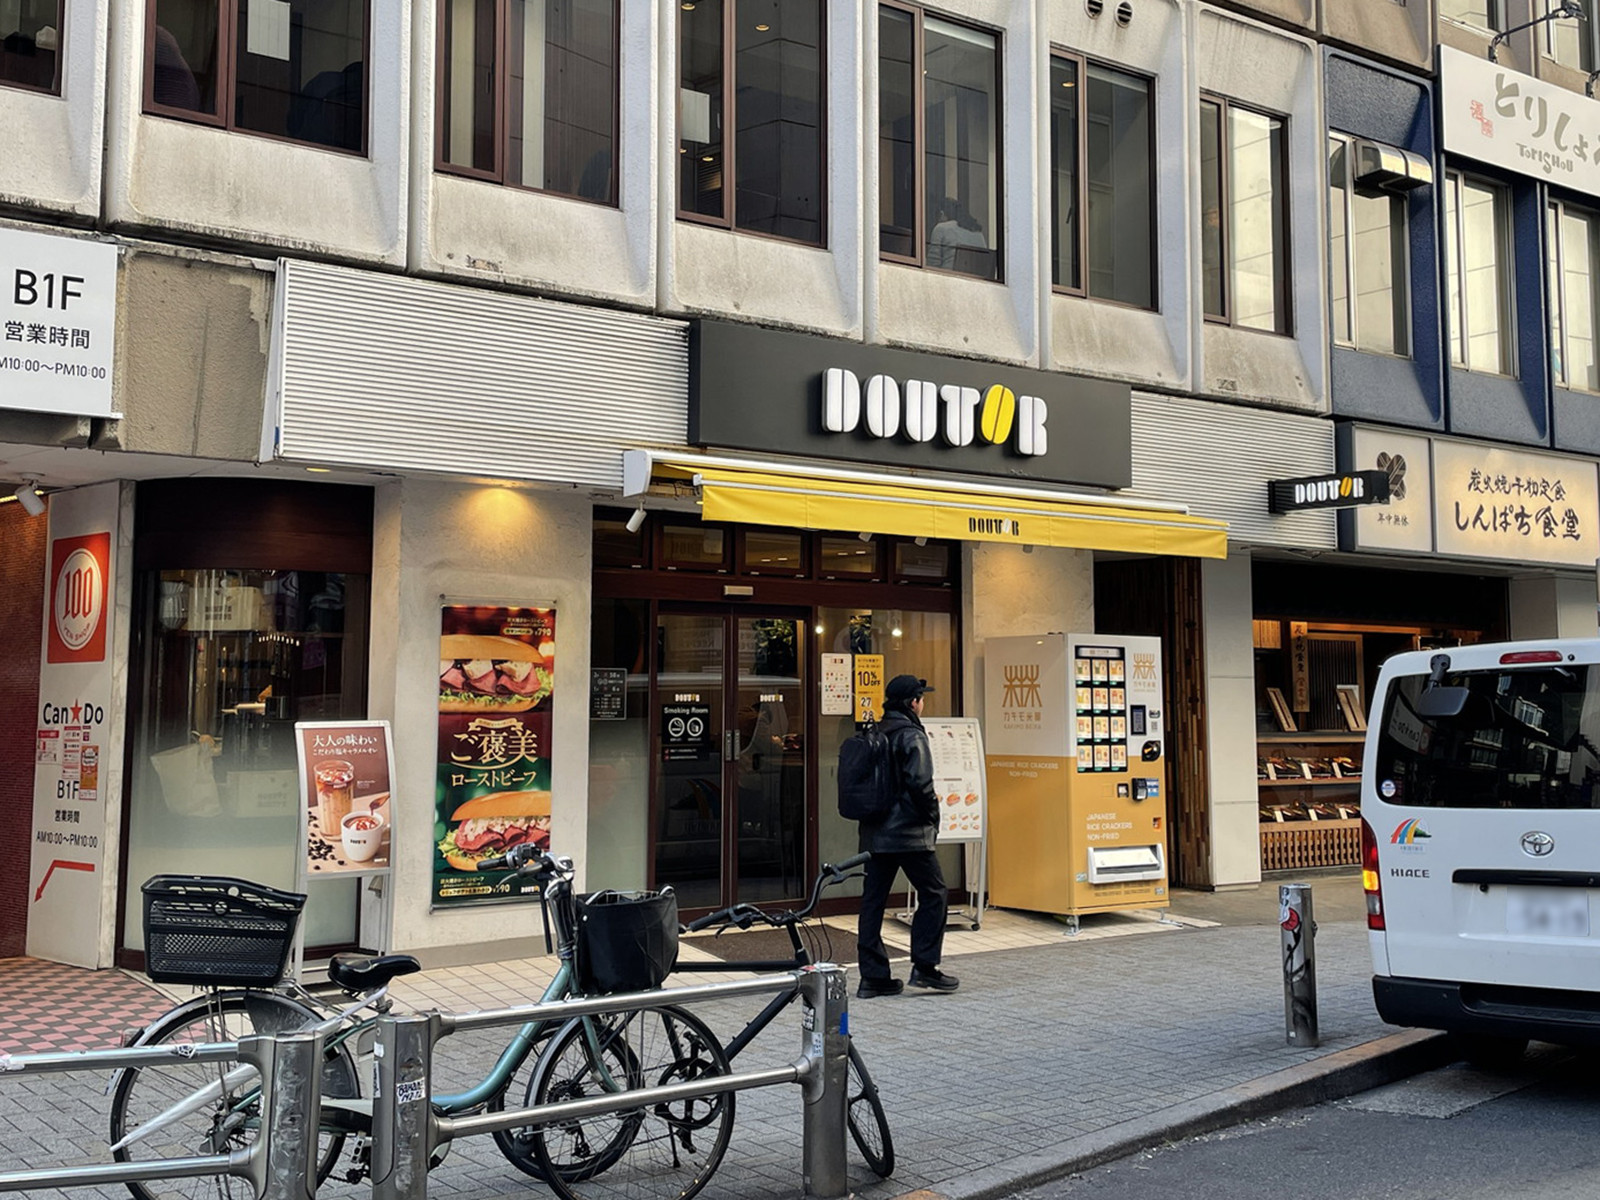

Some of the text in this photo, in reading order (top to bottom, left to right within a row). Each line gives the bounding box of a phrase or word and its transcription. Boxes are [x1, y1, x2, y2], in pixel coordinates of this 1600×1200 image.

[1495, 73, 1600, 166] とりしょ
[14, 269, 85, 310] B1F
[4, 320, 91, 349] 営業時間
[822, 367, 1048, 456] DOUTOR
[1294, 476, 1364, 504] DOUTOR
[969, 517, 1019, 536] DOUTOR
[1455, 501, 1581, 541] しんぱち食堂
[62, 566, 93, 619] 100
[664, 707, 690, 715] Smoking
[312, 734, 378, 748] 大人の味わい
[450, 729, 538, 765] ご褒美
[57, 780, 80, 799] B1F
[451, 769, 537, 788] ローストビーフ
[55, 810, 80, 824] 営業時間
[1391, 868, 1430, 879] HIACE
